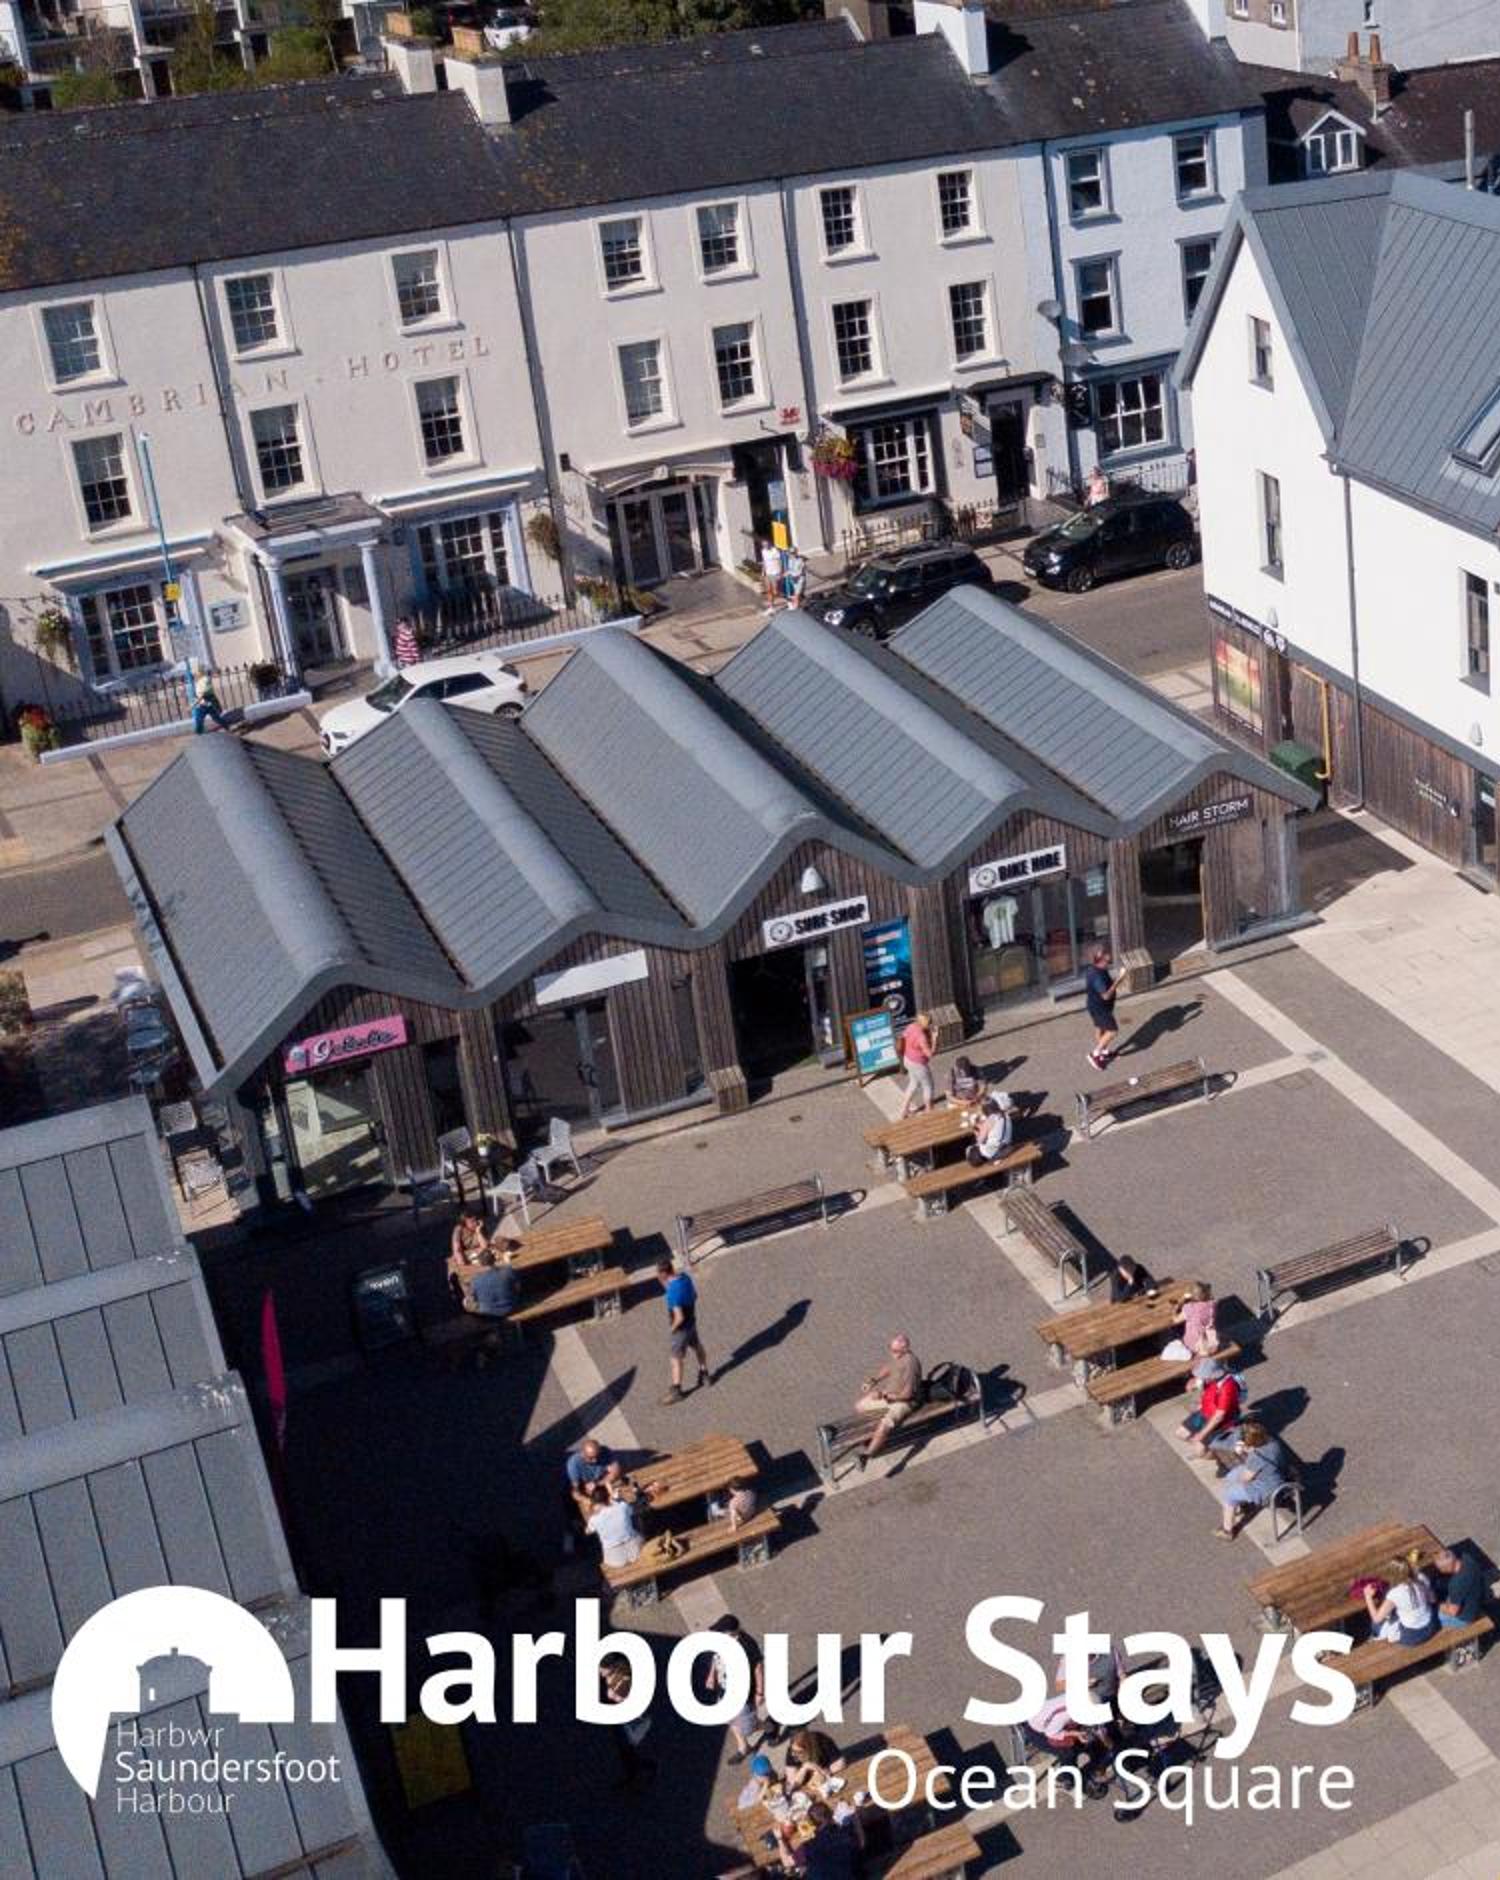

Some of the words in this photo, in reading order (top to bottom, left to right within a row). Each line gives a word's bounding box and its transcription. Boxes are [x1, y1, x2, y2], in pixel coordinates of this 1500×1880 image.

[15, 369, 288, 436] CAMBRIAN
[347, 337, 490, 379] HOTEL
[1168, 810, 1199, 829] HAIR
[1202, 798, 1249, 819] STORM
[998, 859, 1030, 882] BIKE
[1031, 851, 1062, 873] HIRE
[794, 912, 829, 935] SURF
[830, 903, 866, 925] SHOP
